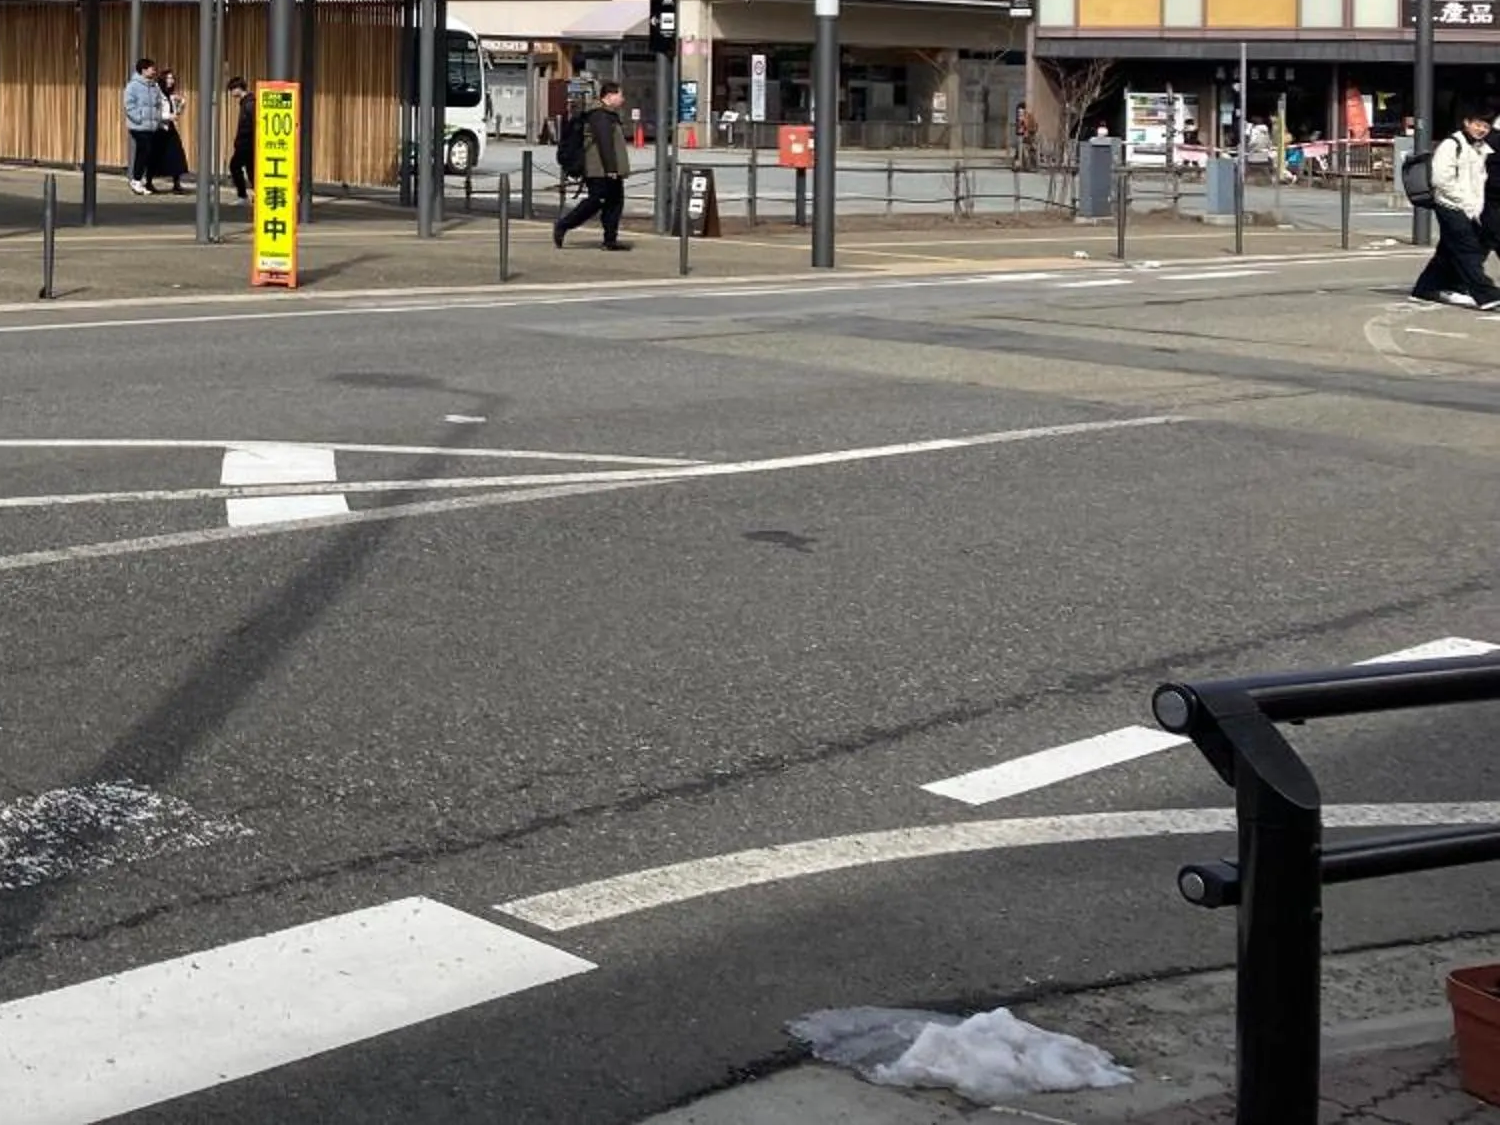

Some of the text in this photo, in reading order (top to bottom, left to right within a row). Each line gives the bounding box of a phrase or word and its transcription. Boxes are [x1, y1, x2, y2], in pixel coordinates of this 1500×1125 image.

[1411, 2, 1494, 24] 産品
[262, 113, 293, 136] 100
[263, 157, 288, 241] 工事中
